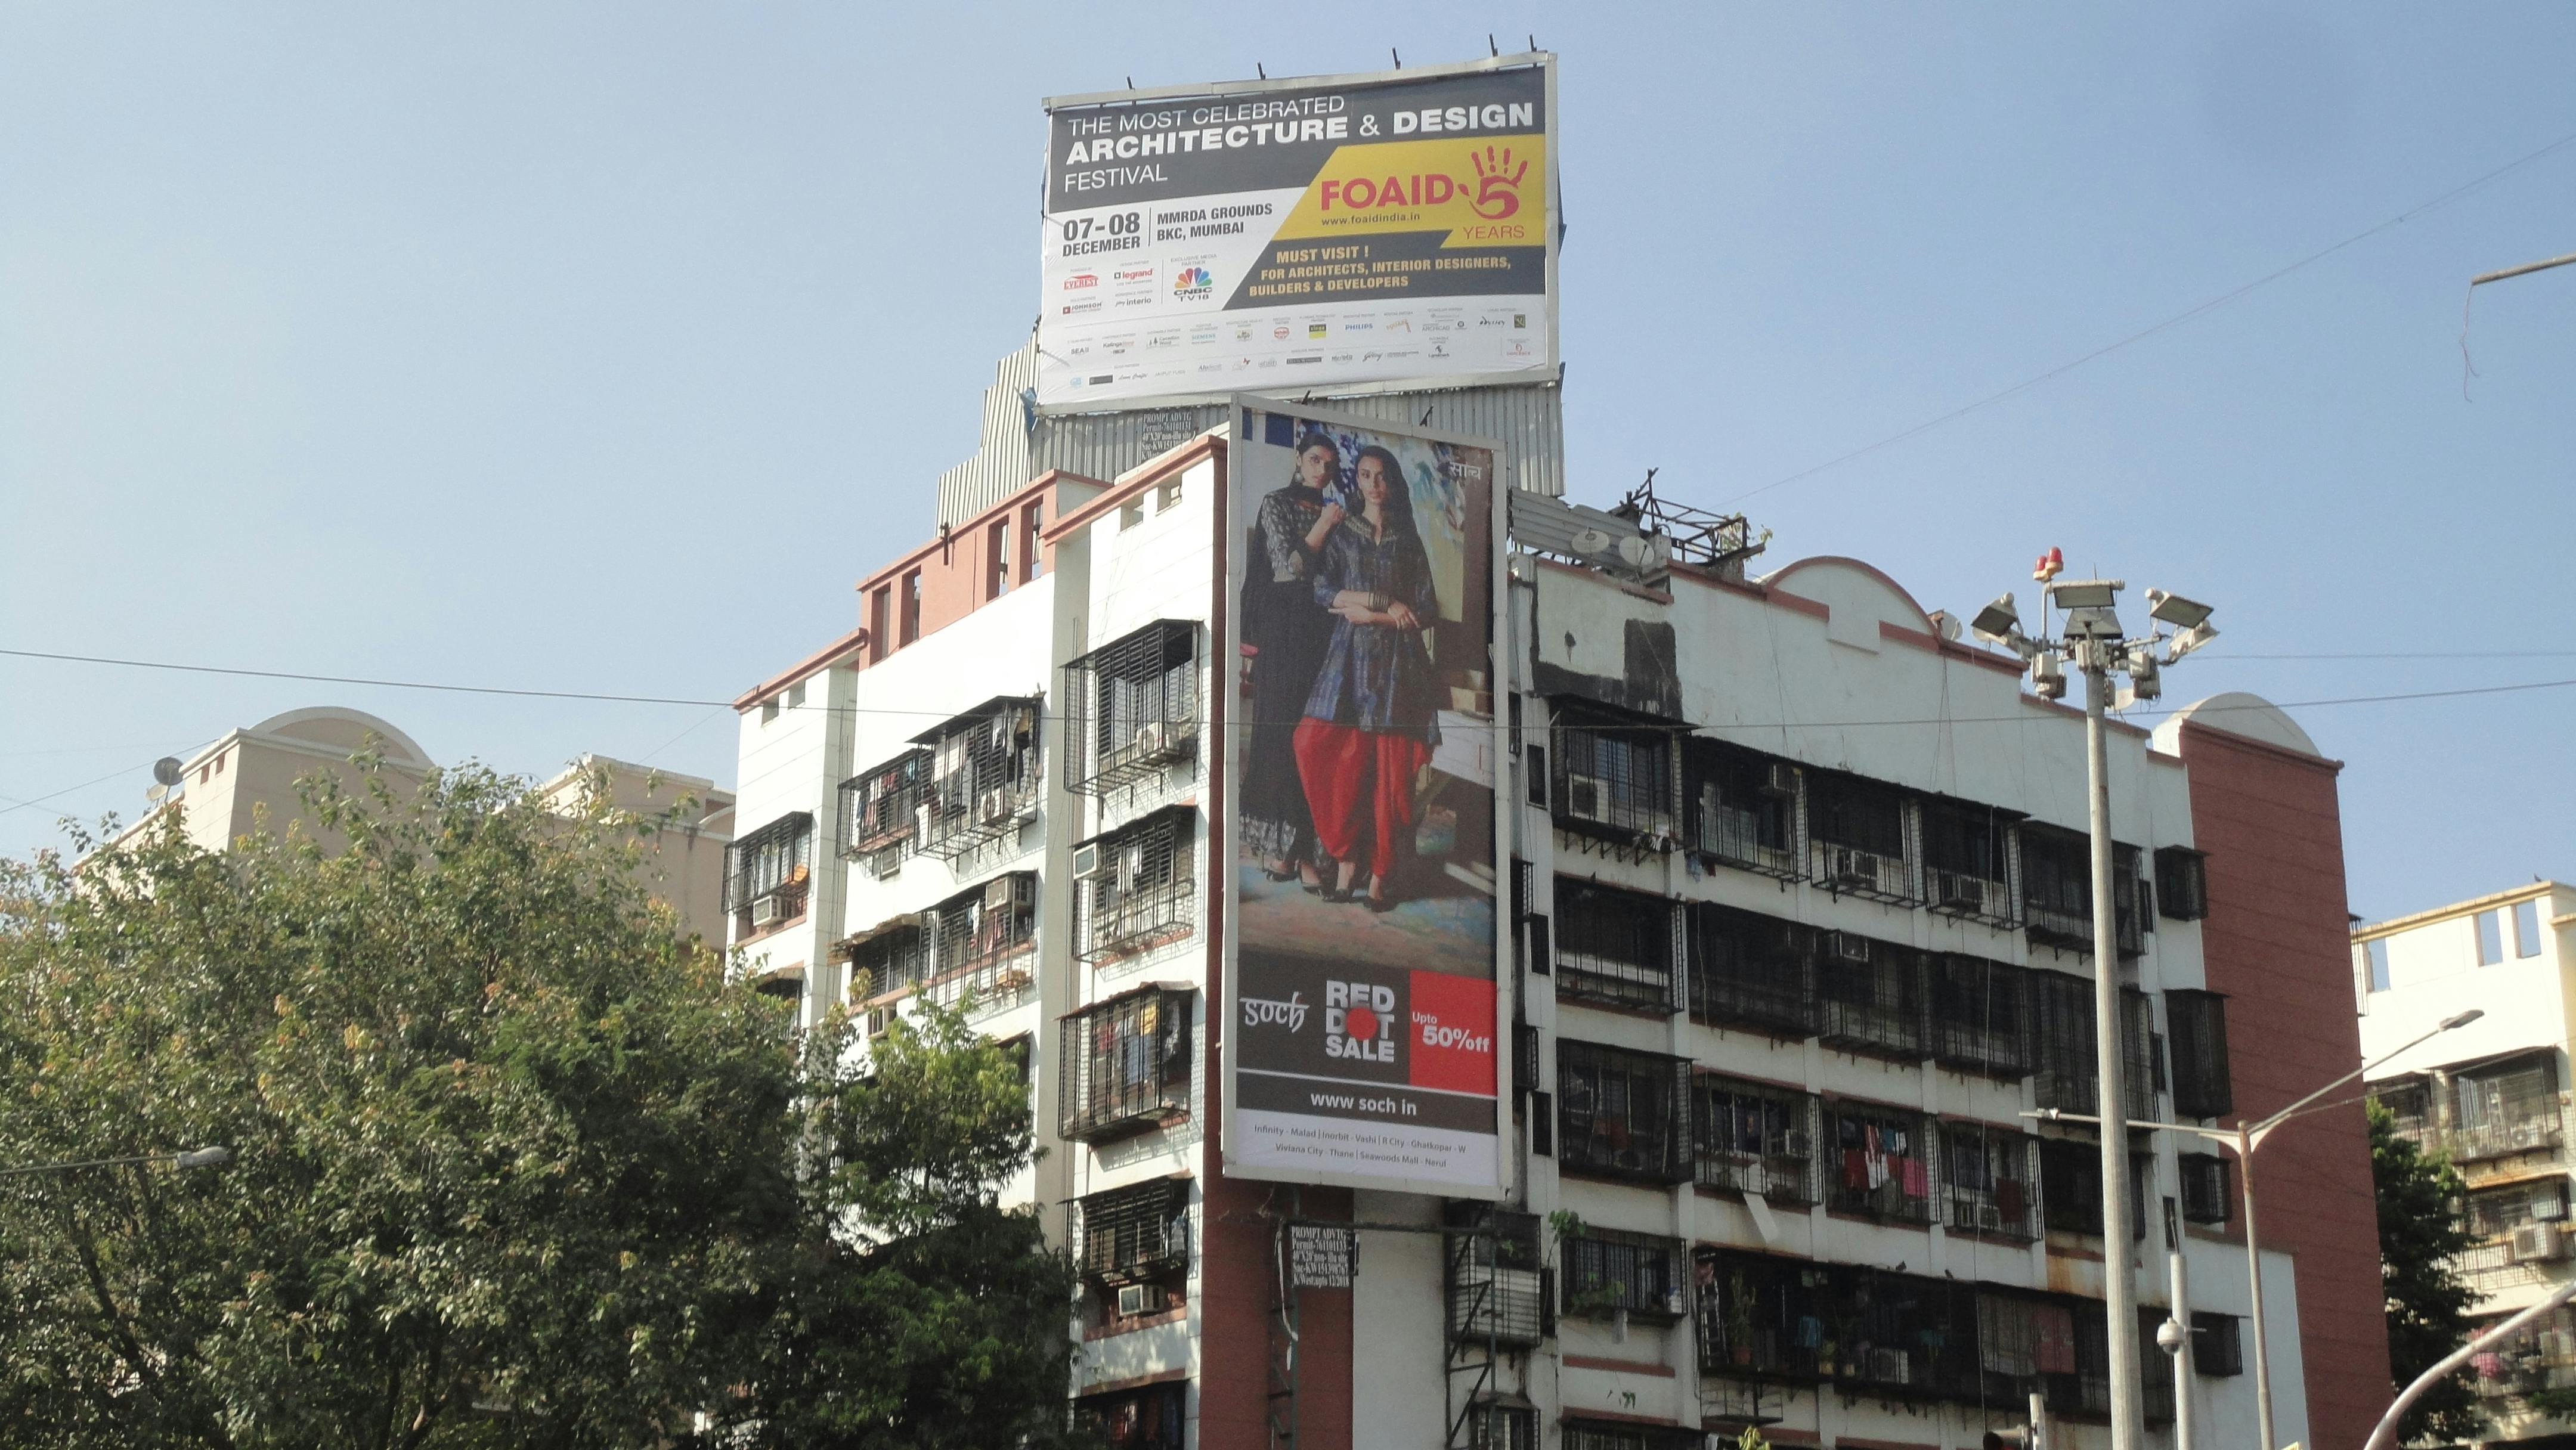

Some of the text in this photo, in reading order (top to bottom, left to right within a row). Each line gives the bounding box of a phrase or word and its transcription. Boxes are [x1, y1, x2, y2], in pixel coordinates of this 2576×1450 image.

[1068, 95, 1345, 136] THE MOST CELEBRATED
[1066, 103, 1533, 165] ARCHITECTURE & DESIGN
[1064, 163, 1168, 193] FESTIVAL
[1321, 173, 1454, 211] FOAID
[1157, 203, 1273, 225] MMRDA GROUNDS
[1321, 213, 1420, 226] www.foaidindia.in
[1063, 212, 1141, 241] 07-08
[1157, 221, 1244, 241] BKC, MUMBAI
[1463, 225, 1525, 240] YEARS
[1062, 236, 1141, 257] DECEMBER
[1276, 248, 1317, 264] MUST
[1322, 246, 1360, 261] VISIT
[1122, 268, 1153, 280] legrand
[1261, 256, 1511, 280] FOR ARCHITECTS, INTERIOR DESIGNERS,
[1063, 277, 1099, 290] EVEREST
[1173, 287, 1212, 296] CNBC
[1249, 276, 1408, 297] BUILDERS & DEVELOPERS
[1126, 296, 1152, 306] interio
[1143, 411, 1191, 423] PROMPT ADVTG
[1326, 980, 1395, 1012] RED
[1239, 991, 1310, 1034] soch
[1412, 1011, 1438, 1025] Upto
[1326, 1035, 1395, 1063] SALE
[1254, 1124, 1284, 1137] Infinity
[1290, 1127, 1316, 1138] Malad
[1322, 1131, 1349, 1142] Inorbit
[1355, 1134, 1376, 1144] Vashi
[1389, 1137, 1405, 1148] City
[1411, 1140, 1452, 1153] Ghatkopar
[1275, 1143, 1305, 1154] Viviana
[1307, 1146, 1324, 1157] City
[1330, 1148, 1354, 1158] Thane
[1292, 1226, 1320, 1239] PROMPT
